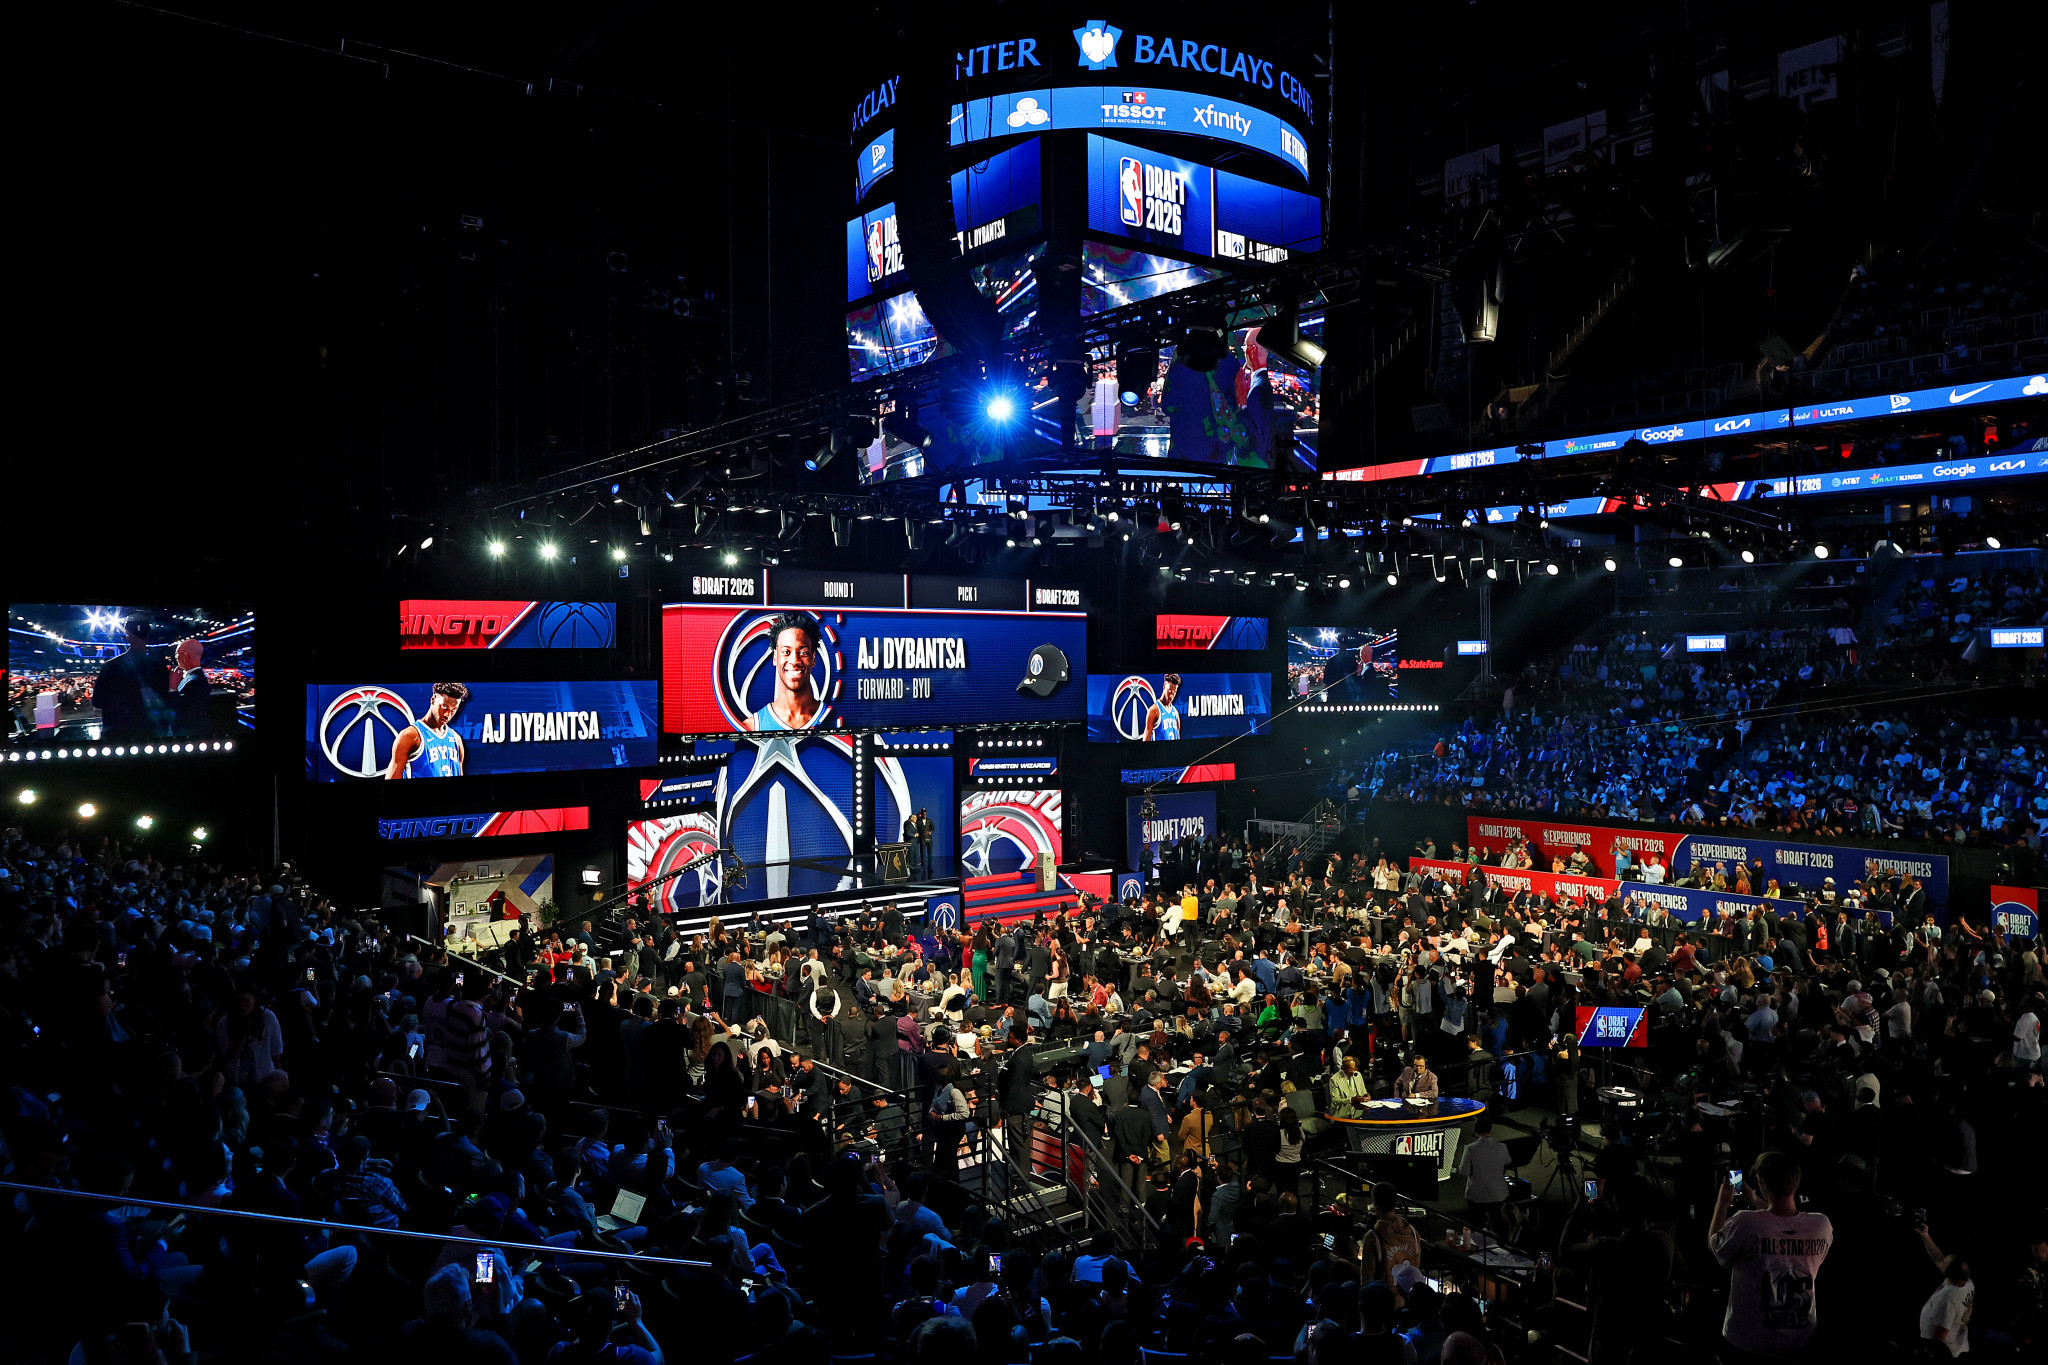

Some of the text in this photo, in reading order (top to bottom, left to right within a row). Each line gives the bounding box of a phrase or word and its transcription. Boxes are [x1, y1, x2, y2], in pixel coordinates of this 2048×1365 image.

[1135, 35, 1273, 89] BARCLAYS
[1101, 105, 1166, 119] TISSOT
[1193, 104, 1251, 136] xfinity
[1145, 164, 1186, 205] DRAFT
[1145, 197, 1182, 236] 2026
[974, 218, 1006, 248] DYBANTSA
[1223, 235, 1227, 253] 1
[1820, 407, 1854, 417] ULTRA
[1641, 426, 1684, 441] Google
[1456, 451, 1495, 469] DRAFT 2026
[1933, 463, 1976, 477] Google
[1801, 478, 1822, 492] 2026
[1842, 476, 1861, 486] AT&T
[701, 577, 754, 596] DRAFT 2026
[824, 581, 854, 598] ROUND 1
[957, 586, 978, 602] PICK 1
[1042, 589, 1080, 605] DRAFT 2026
[2000, 631, 2042, 644] DRAFT 2026
[857, 637, 966, 670] AJ DYBANTSA
[858, 678, 904, 700] FORWARD
[912, 677, 931, 699] BYU
[1187, 694, 1245, 717] AJ DYBANTSA
[482, 713, 506, 744] AJ
[510, 711, 600, 742] DYBANTSA
[429, 745, 459, 763] BYU
[662, 780, 713, 793] WASHINGTON WIZARDS
[1151, 818, 1179, 842] DRAFT
[1484, 824, 1521, 840] DRAFT 2026
[1549, 830, 1591, 846] EXPERIENCES
[1644, 838, 1664, 853] 2026
[1697, 843, 1747, 861] EXPERIENCES
[1783, 850, 1834, 869] DRAFT 2026
[1561, 883, 1584, 899] DRAFT
[2010, 913, 2031, 926] DRAFT
[2010, 924, 2029, 936] 2026
[1608, 1015, 1628, 1027] DRAFT
[1608, 1027, 1626, 1038] 2026
[1414, 1132, 1444, 1152] DRAFT
